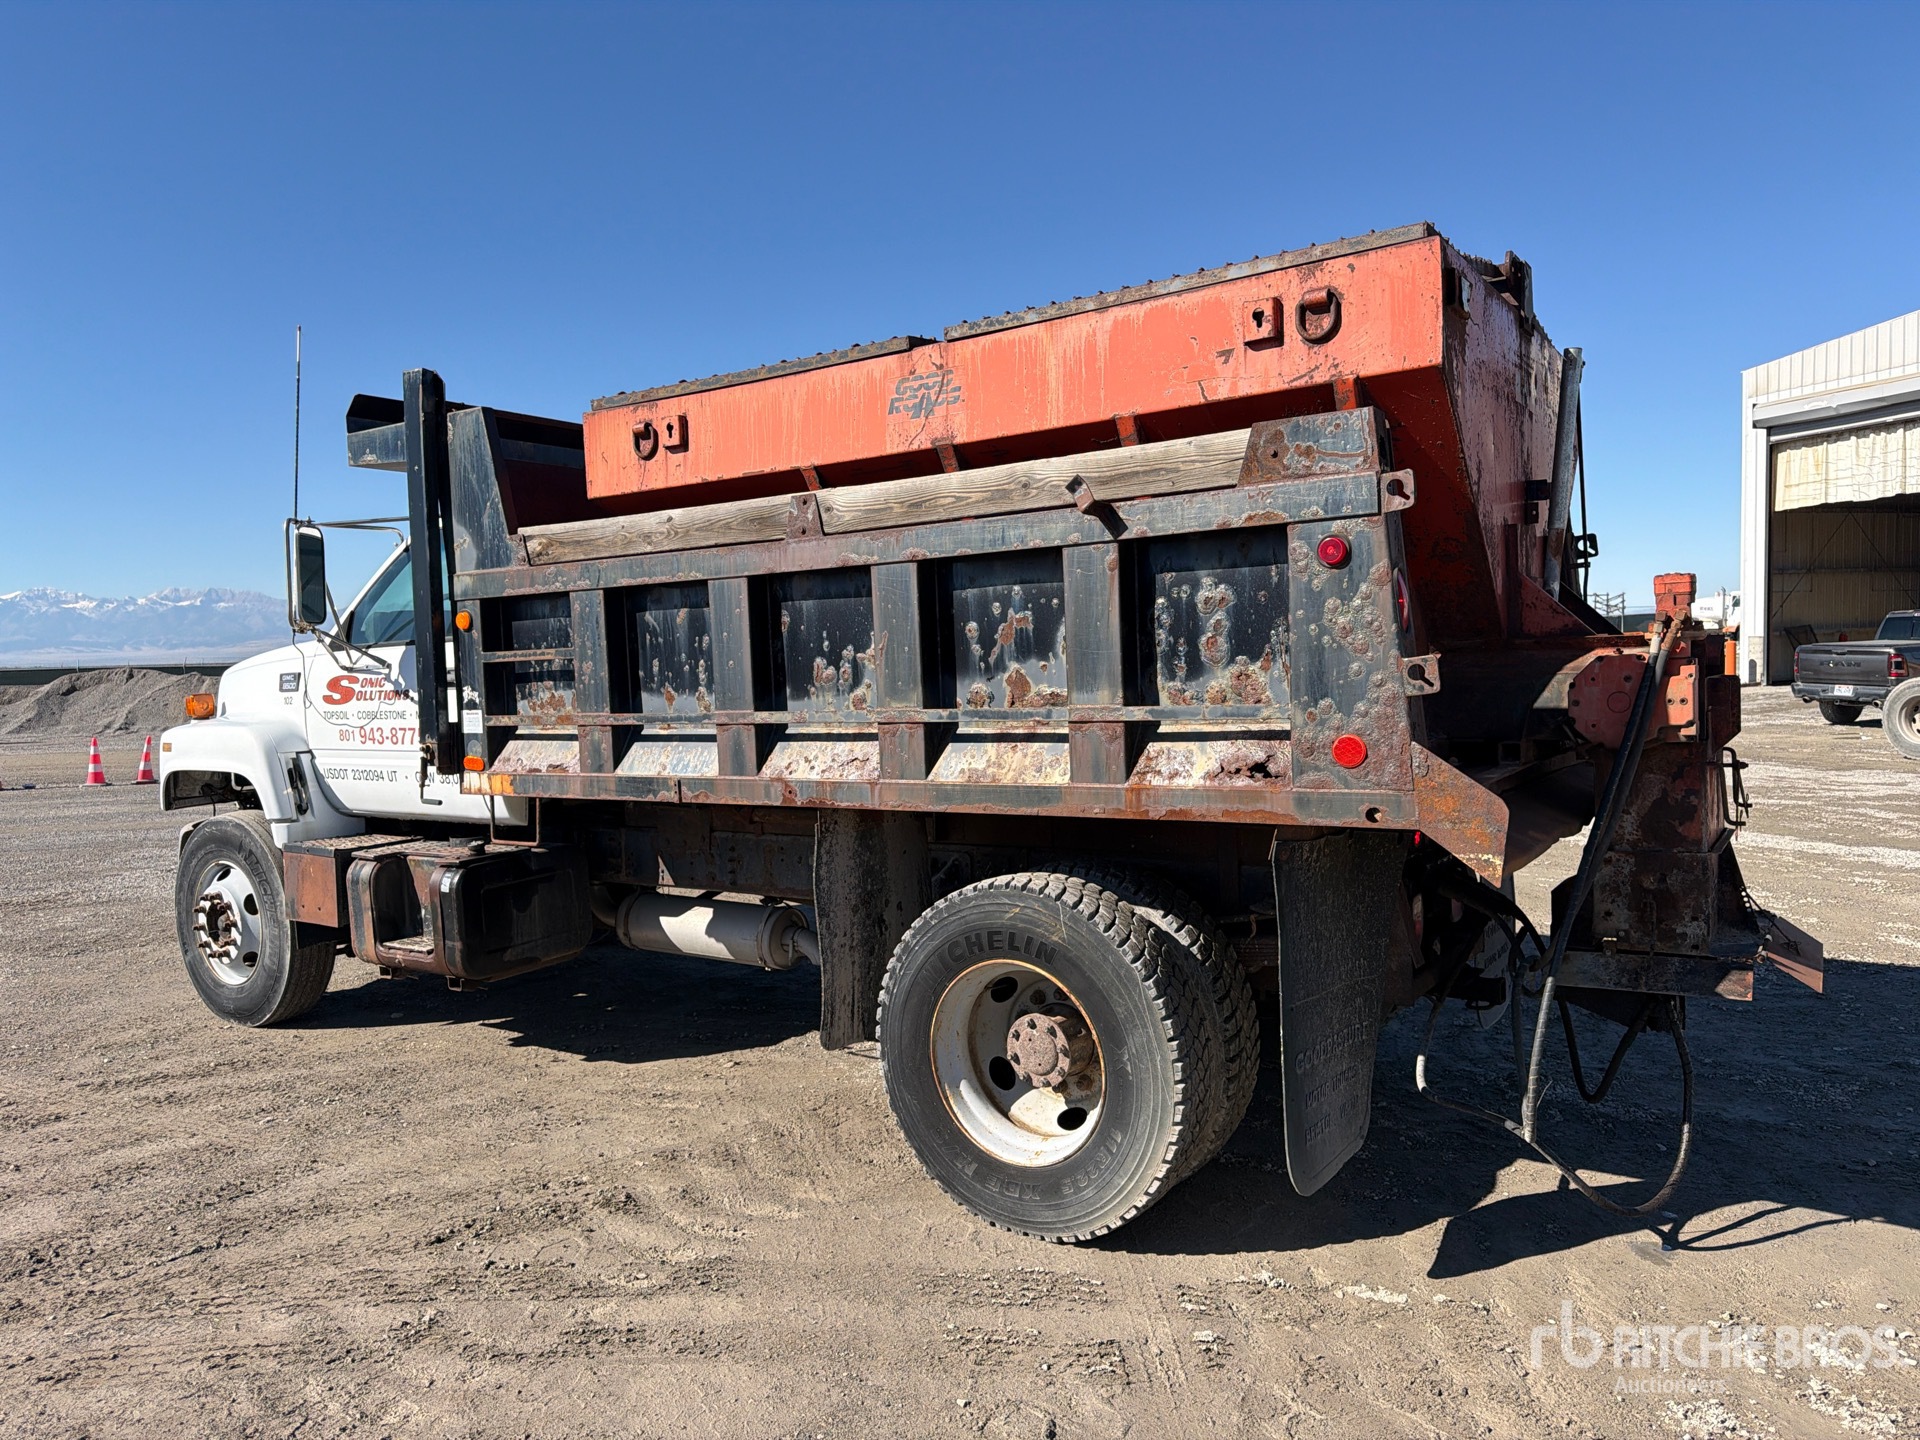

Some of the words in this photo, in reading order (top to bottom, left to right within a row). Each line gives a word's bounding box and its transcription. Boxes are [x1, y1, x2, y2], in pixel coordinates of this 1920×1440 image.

[323, 711, 350, 720] TOPSOIL
[357, 711, 407, 720] COBBLESTONE
[339, 729, 355, 741] 801
[359, 726, 421, 745] 943-877
[323, 768, 349, 780] USDOT
[351, 769, 384, 781] 2312094
[386, 770, 398, 782] UT
